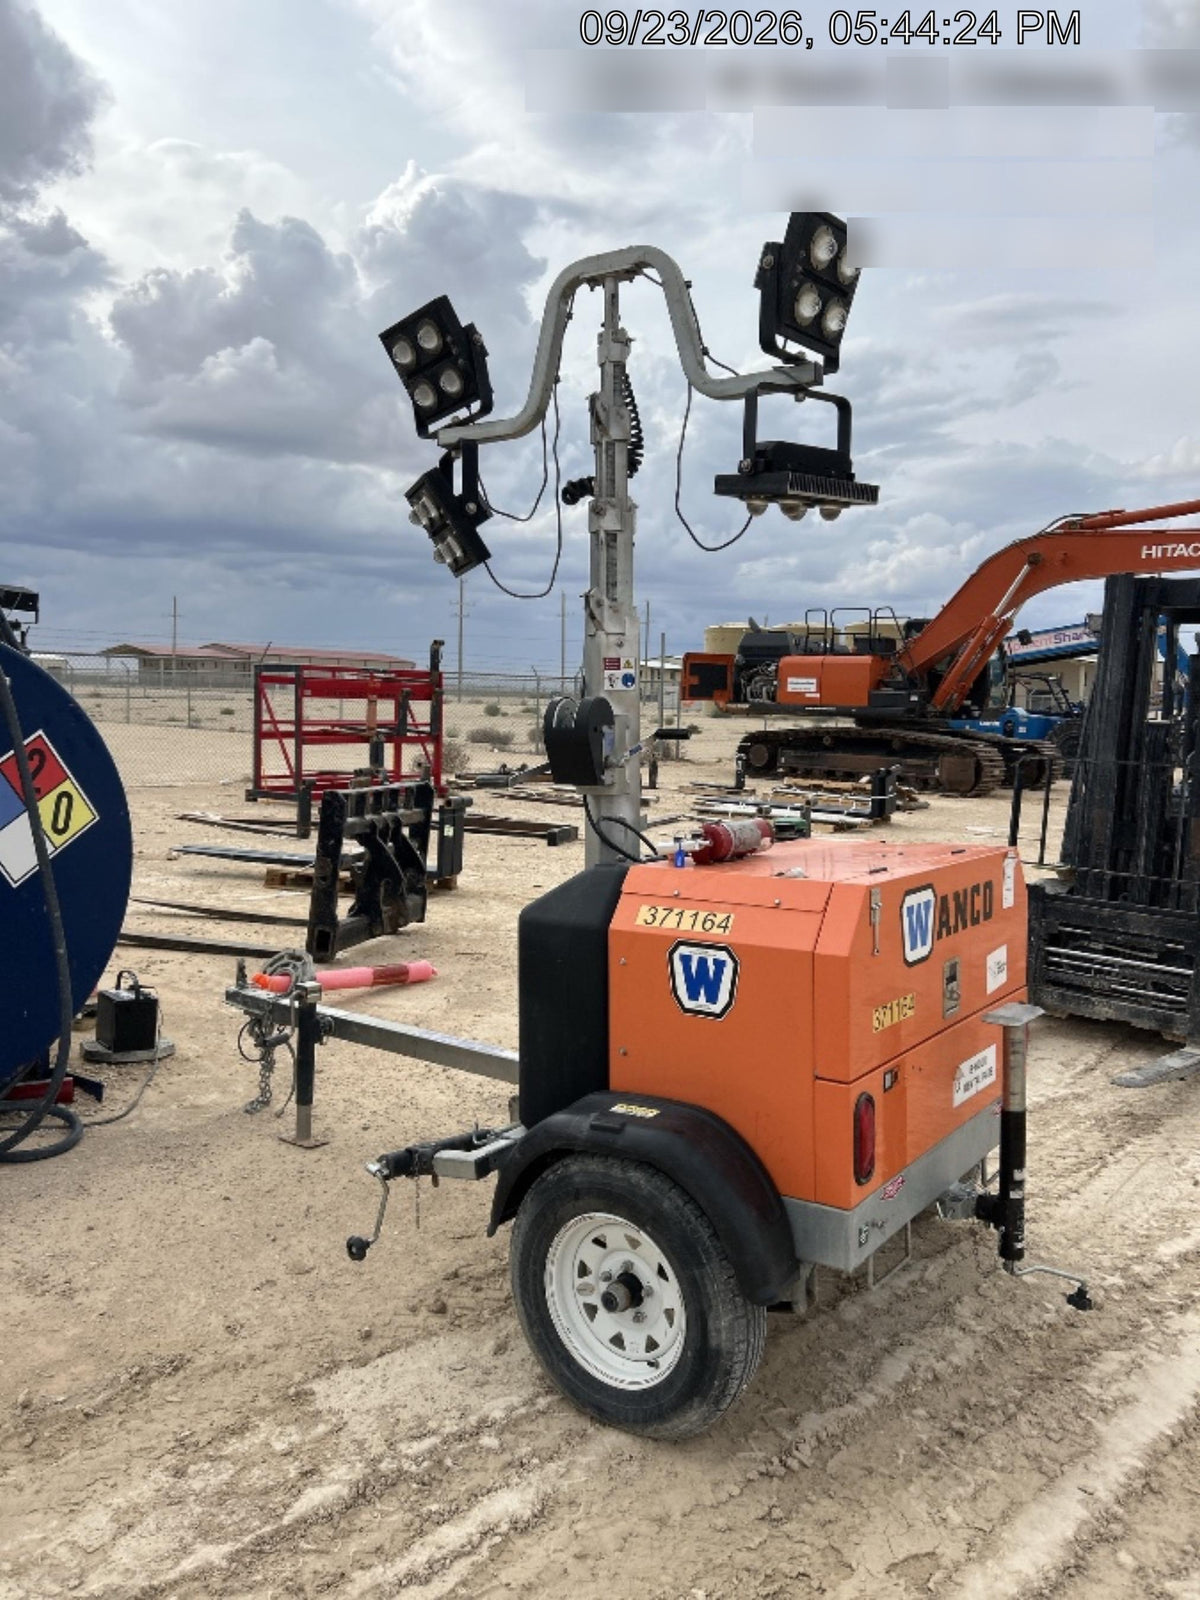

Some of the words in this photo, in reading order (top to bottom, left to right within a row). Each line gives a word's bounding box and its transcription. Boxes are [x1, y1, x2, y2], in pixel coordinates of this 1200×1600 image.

[1141, 543, 1200, 559] HITAC
[51, 791, 73, 835] 0
[643, 906, 732, 934] 371164
[906, 880, 993, 952] WANCO
[679, 952, 727, 1005] W
[874, 993, 915, 1031] 371164
